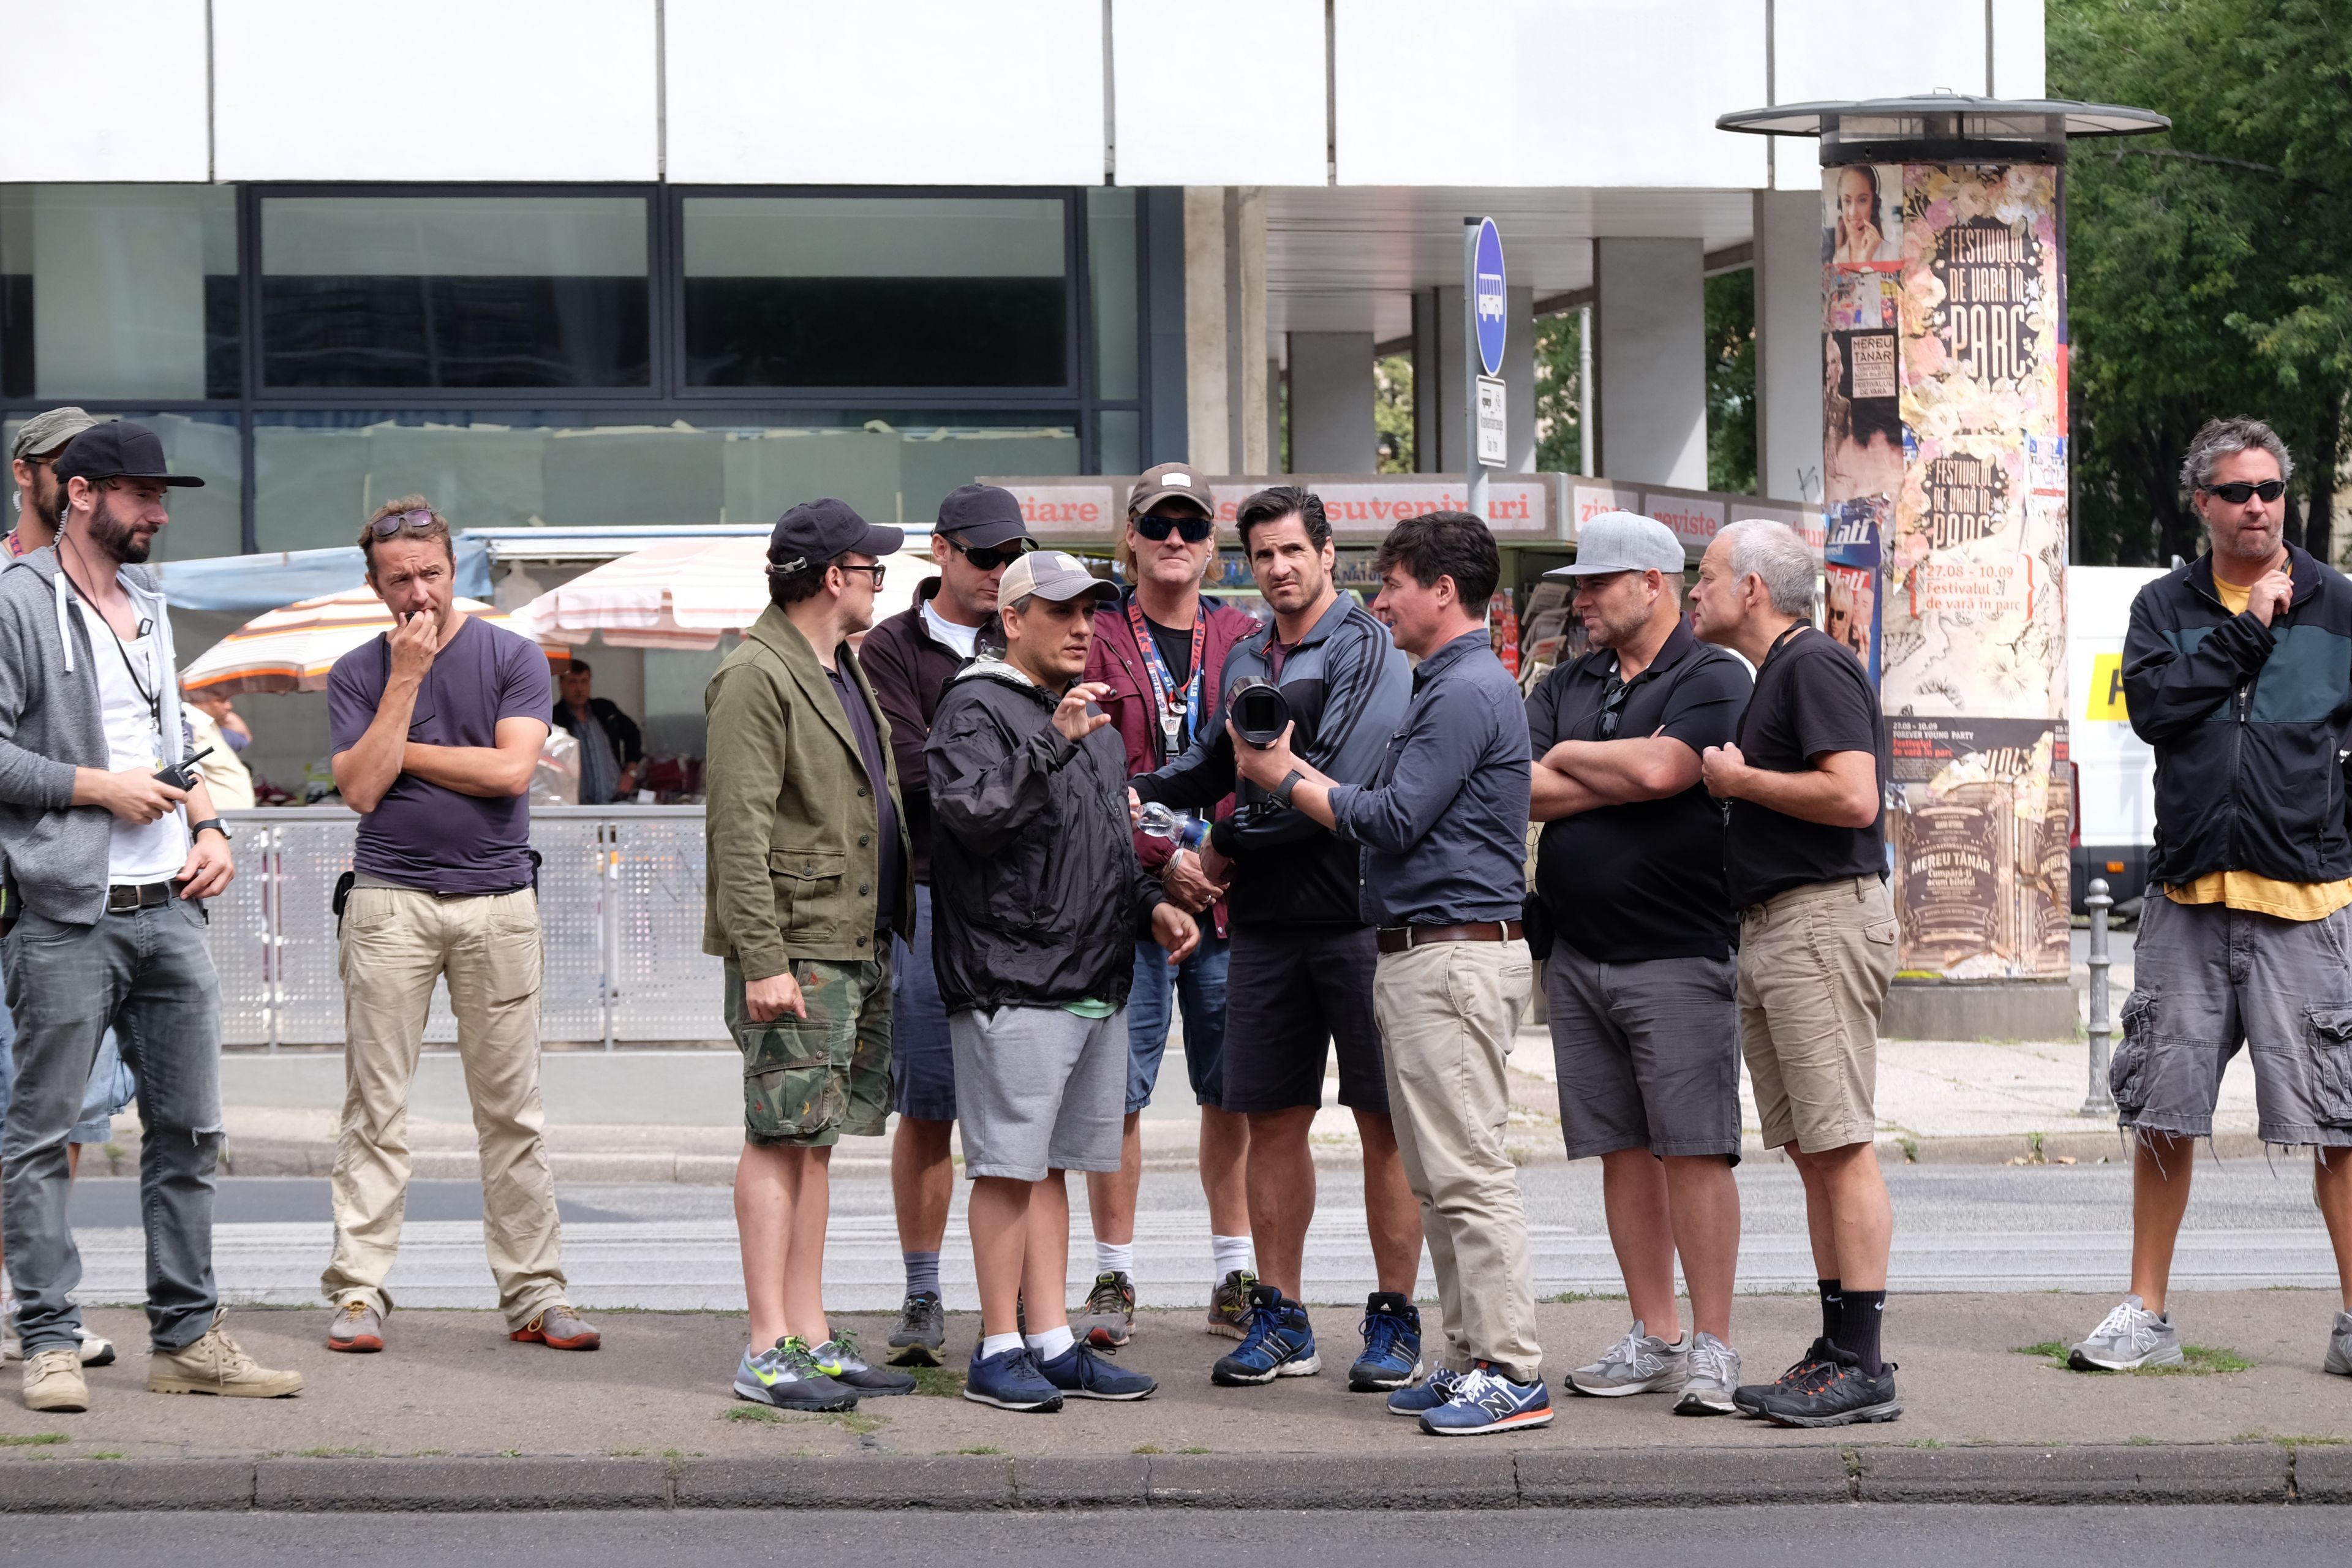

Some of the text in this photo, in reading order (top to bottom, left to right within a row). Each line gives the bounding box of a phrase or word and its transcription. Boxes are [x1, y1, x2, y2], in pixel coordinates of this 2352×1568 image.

[1949, 267, 1967, 303] DE
[2010, 262, 2024, 303] ÎN
[1853, 337, 1892, 349] MEREU
[1950, 304, 2027, 379] PARC
[1934, 487, 1947, 512] DE
[1926, 565, 1964, 577] 27.08
[1980, 566, 2013, 578] 10.09
[1927, 582, 1990, 595] Festivalul
[1926, 597, 1942, 609] de
[1997, 601, 2021, 614] parc
[1924, 731, 1949, 740] YOUNG
[1951, 731, 1973, 740] PARTY
[1911, 852, 1951, 875] MEREU
[1926, 876, 1975, 887] acum biletul
